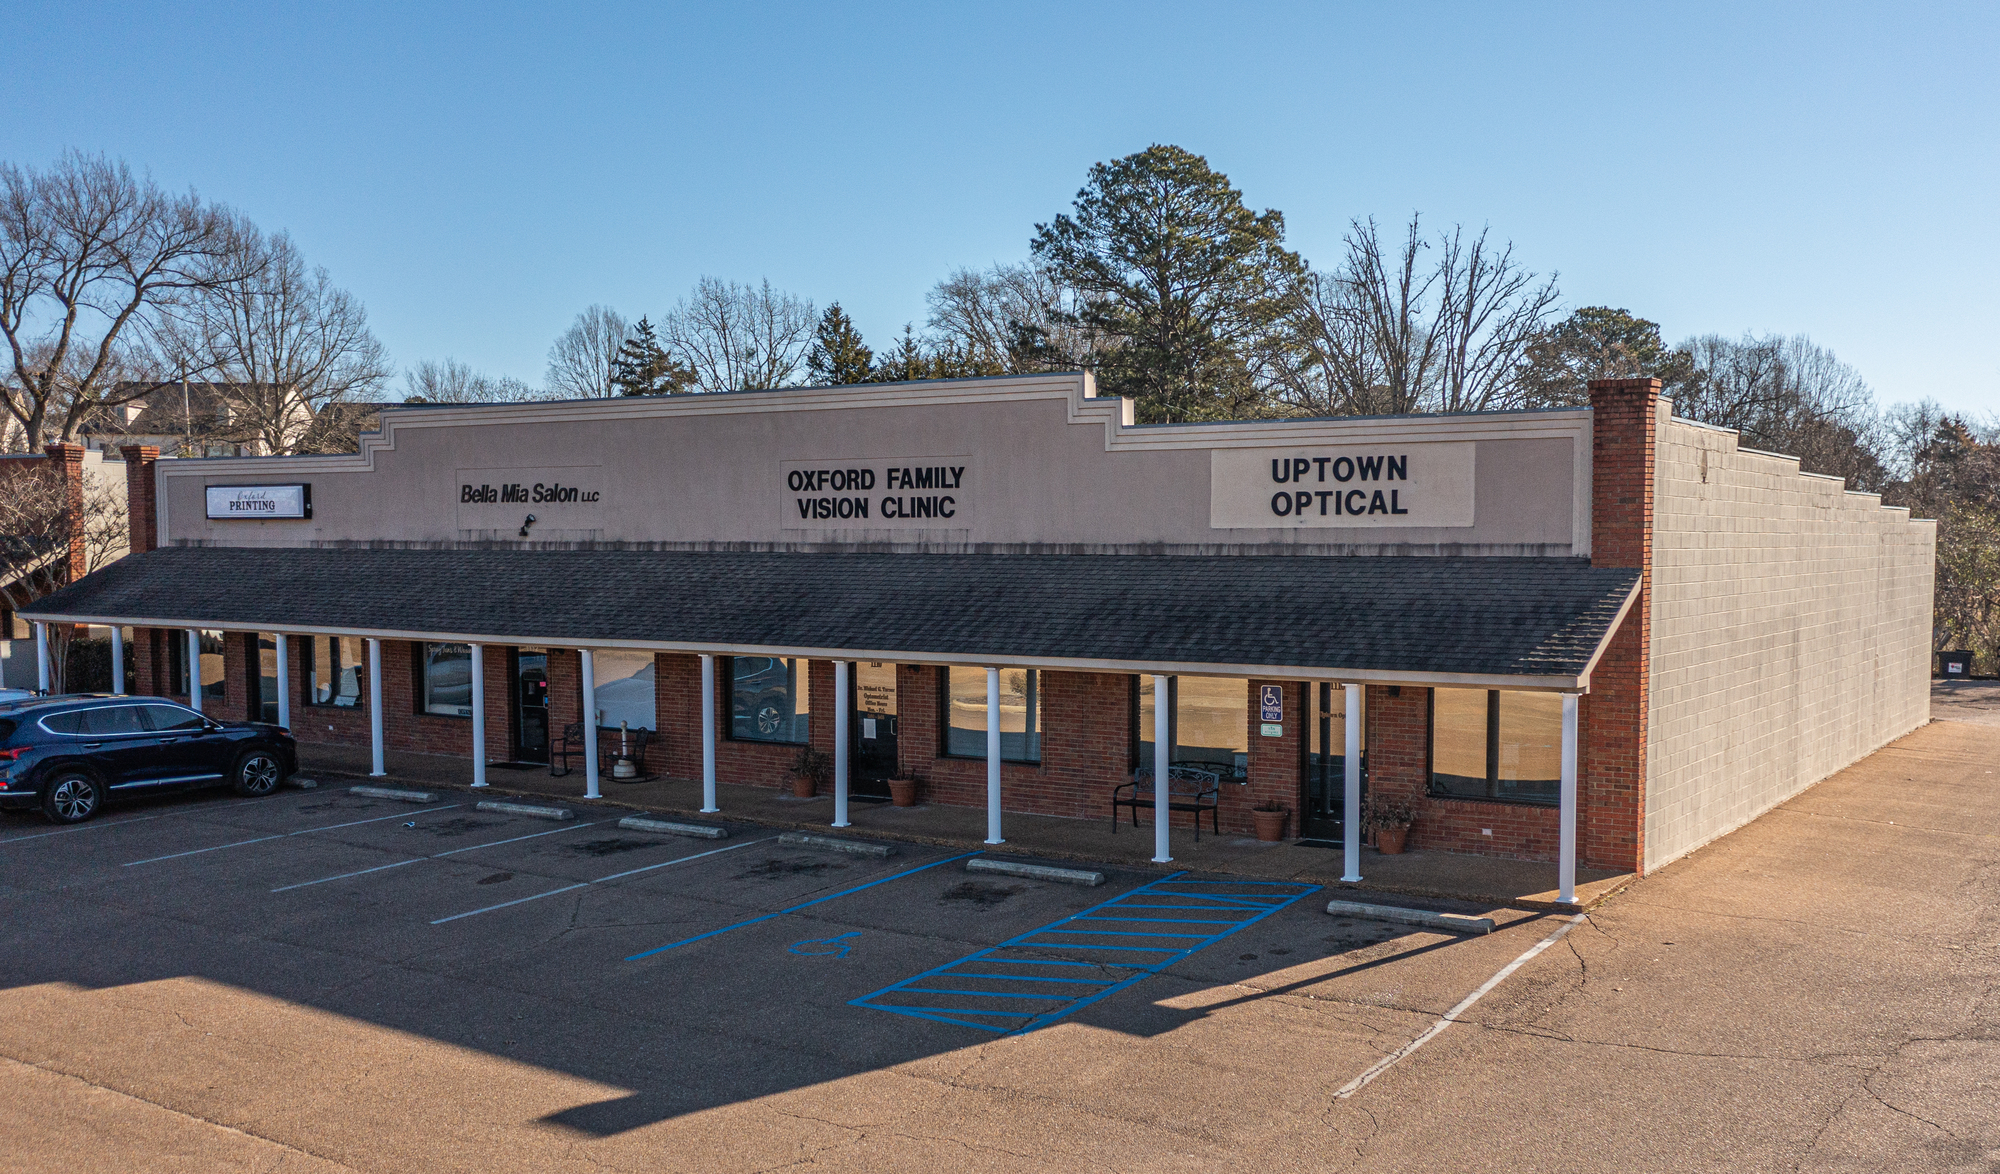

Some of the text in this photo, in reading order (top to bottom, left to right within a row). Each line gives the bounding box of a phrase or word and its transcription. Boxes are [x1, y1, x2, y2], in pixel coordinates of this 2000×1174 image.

[788, 466, 965, 491] OXFORD FAMILY
[1272, 455, 1407, 483] UPTOWN
[237, 490, 267, 501] Oxford
[460, 483, 600, 503] Bella Mia Salon LLC
[1271, 489, 1409, 516] OPTICAL
[229, 500, 276, 511] PRINTING
[797, 495, 956, 519] VISION CLINIC
